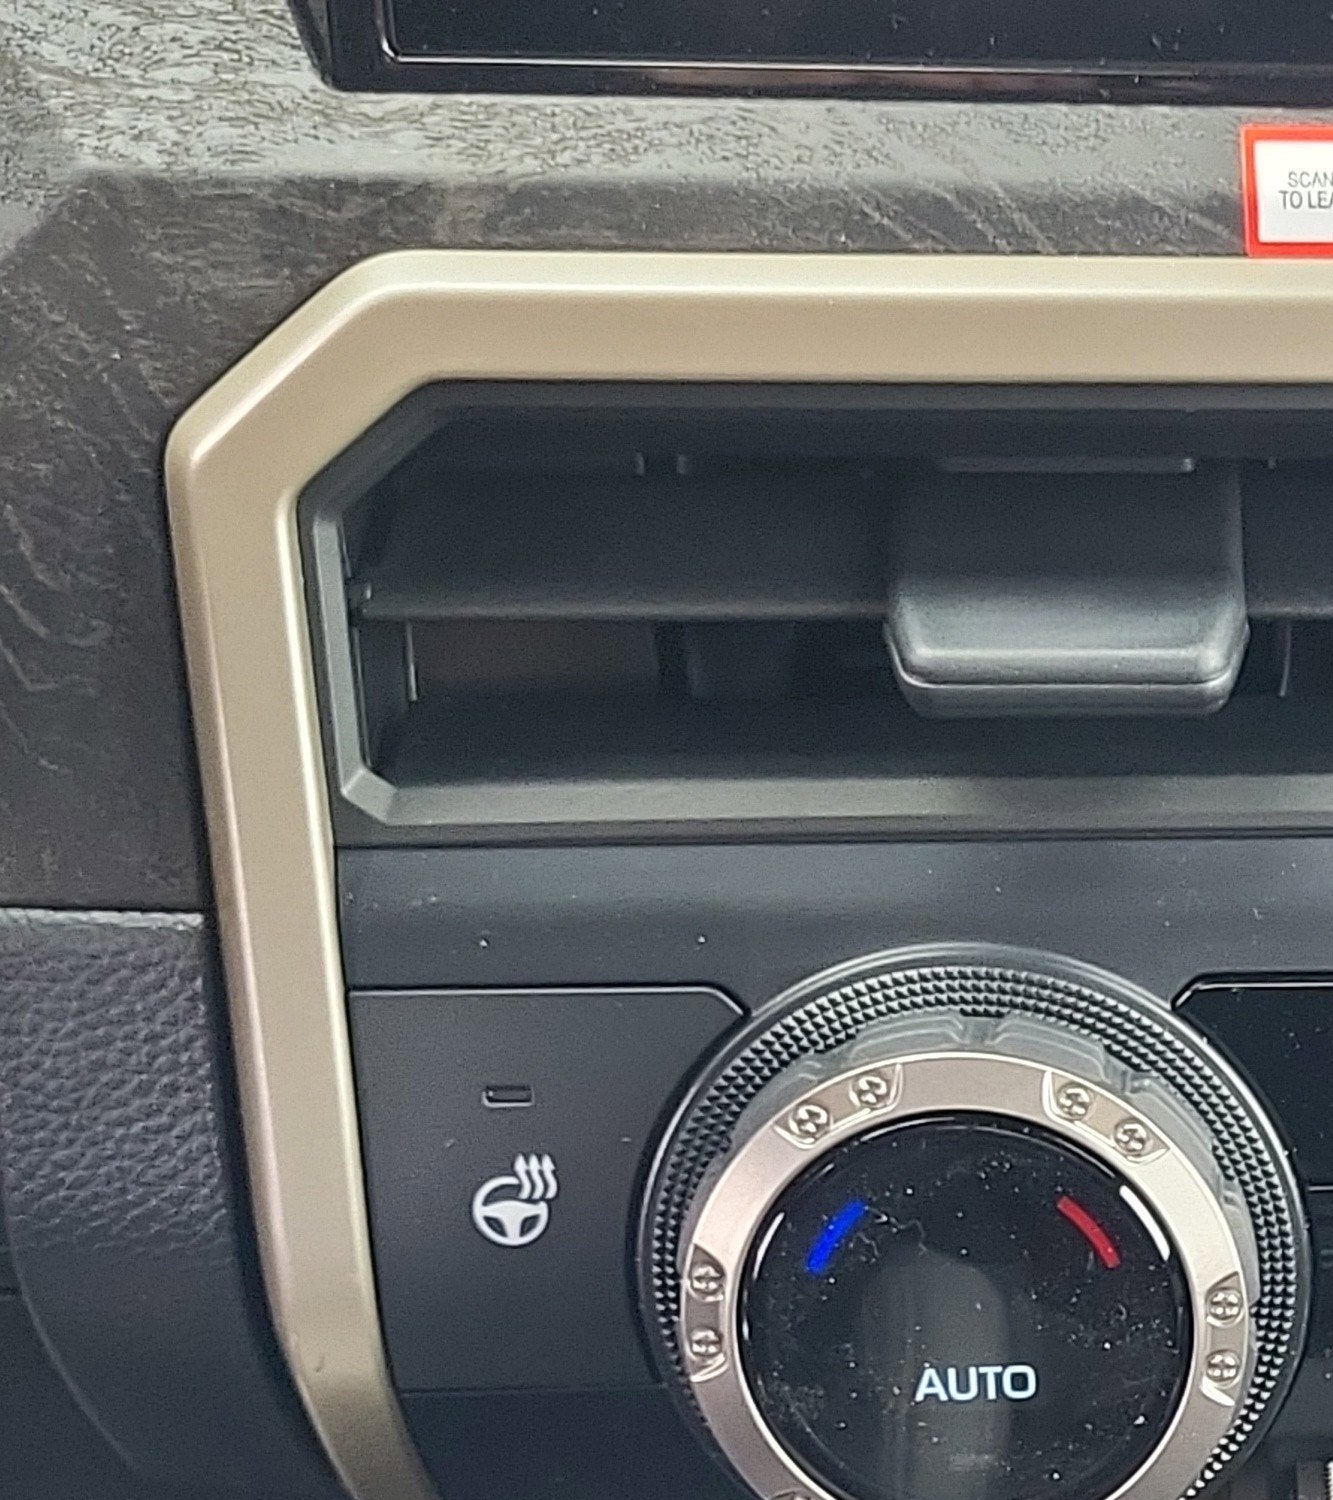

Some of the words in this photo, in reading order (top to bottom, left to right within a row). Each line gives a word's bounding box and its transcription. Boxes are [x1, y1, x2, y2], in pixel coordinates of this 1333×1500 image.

[1288, 171, 1333, 188] SCAN
[1279, 190, 1303, 209] TO
[915, 1363, 1037, 1402] AUTO
